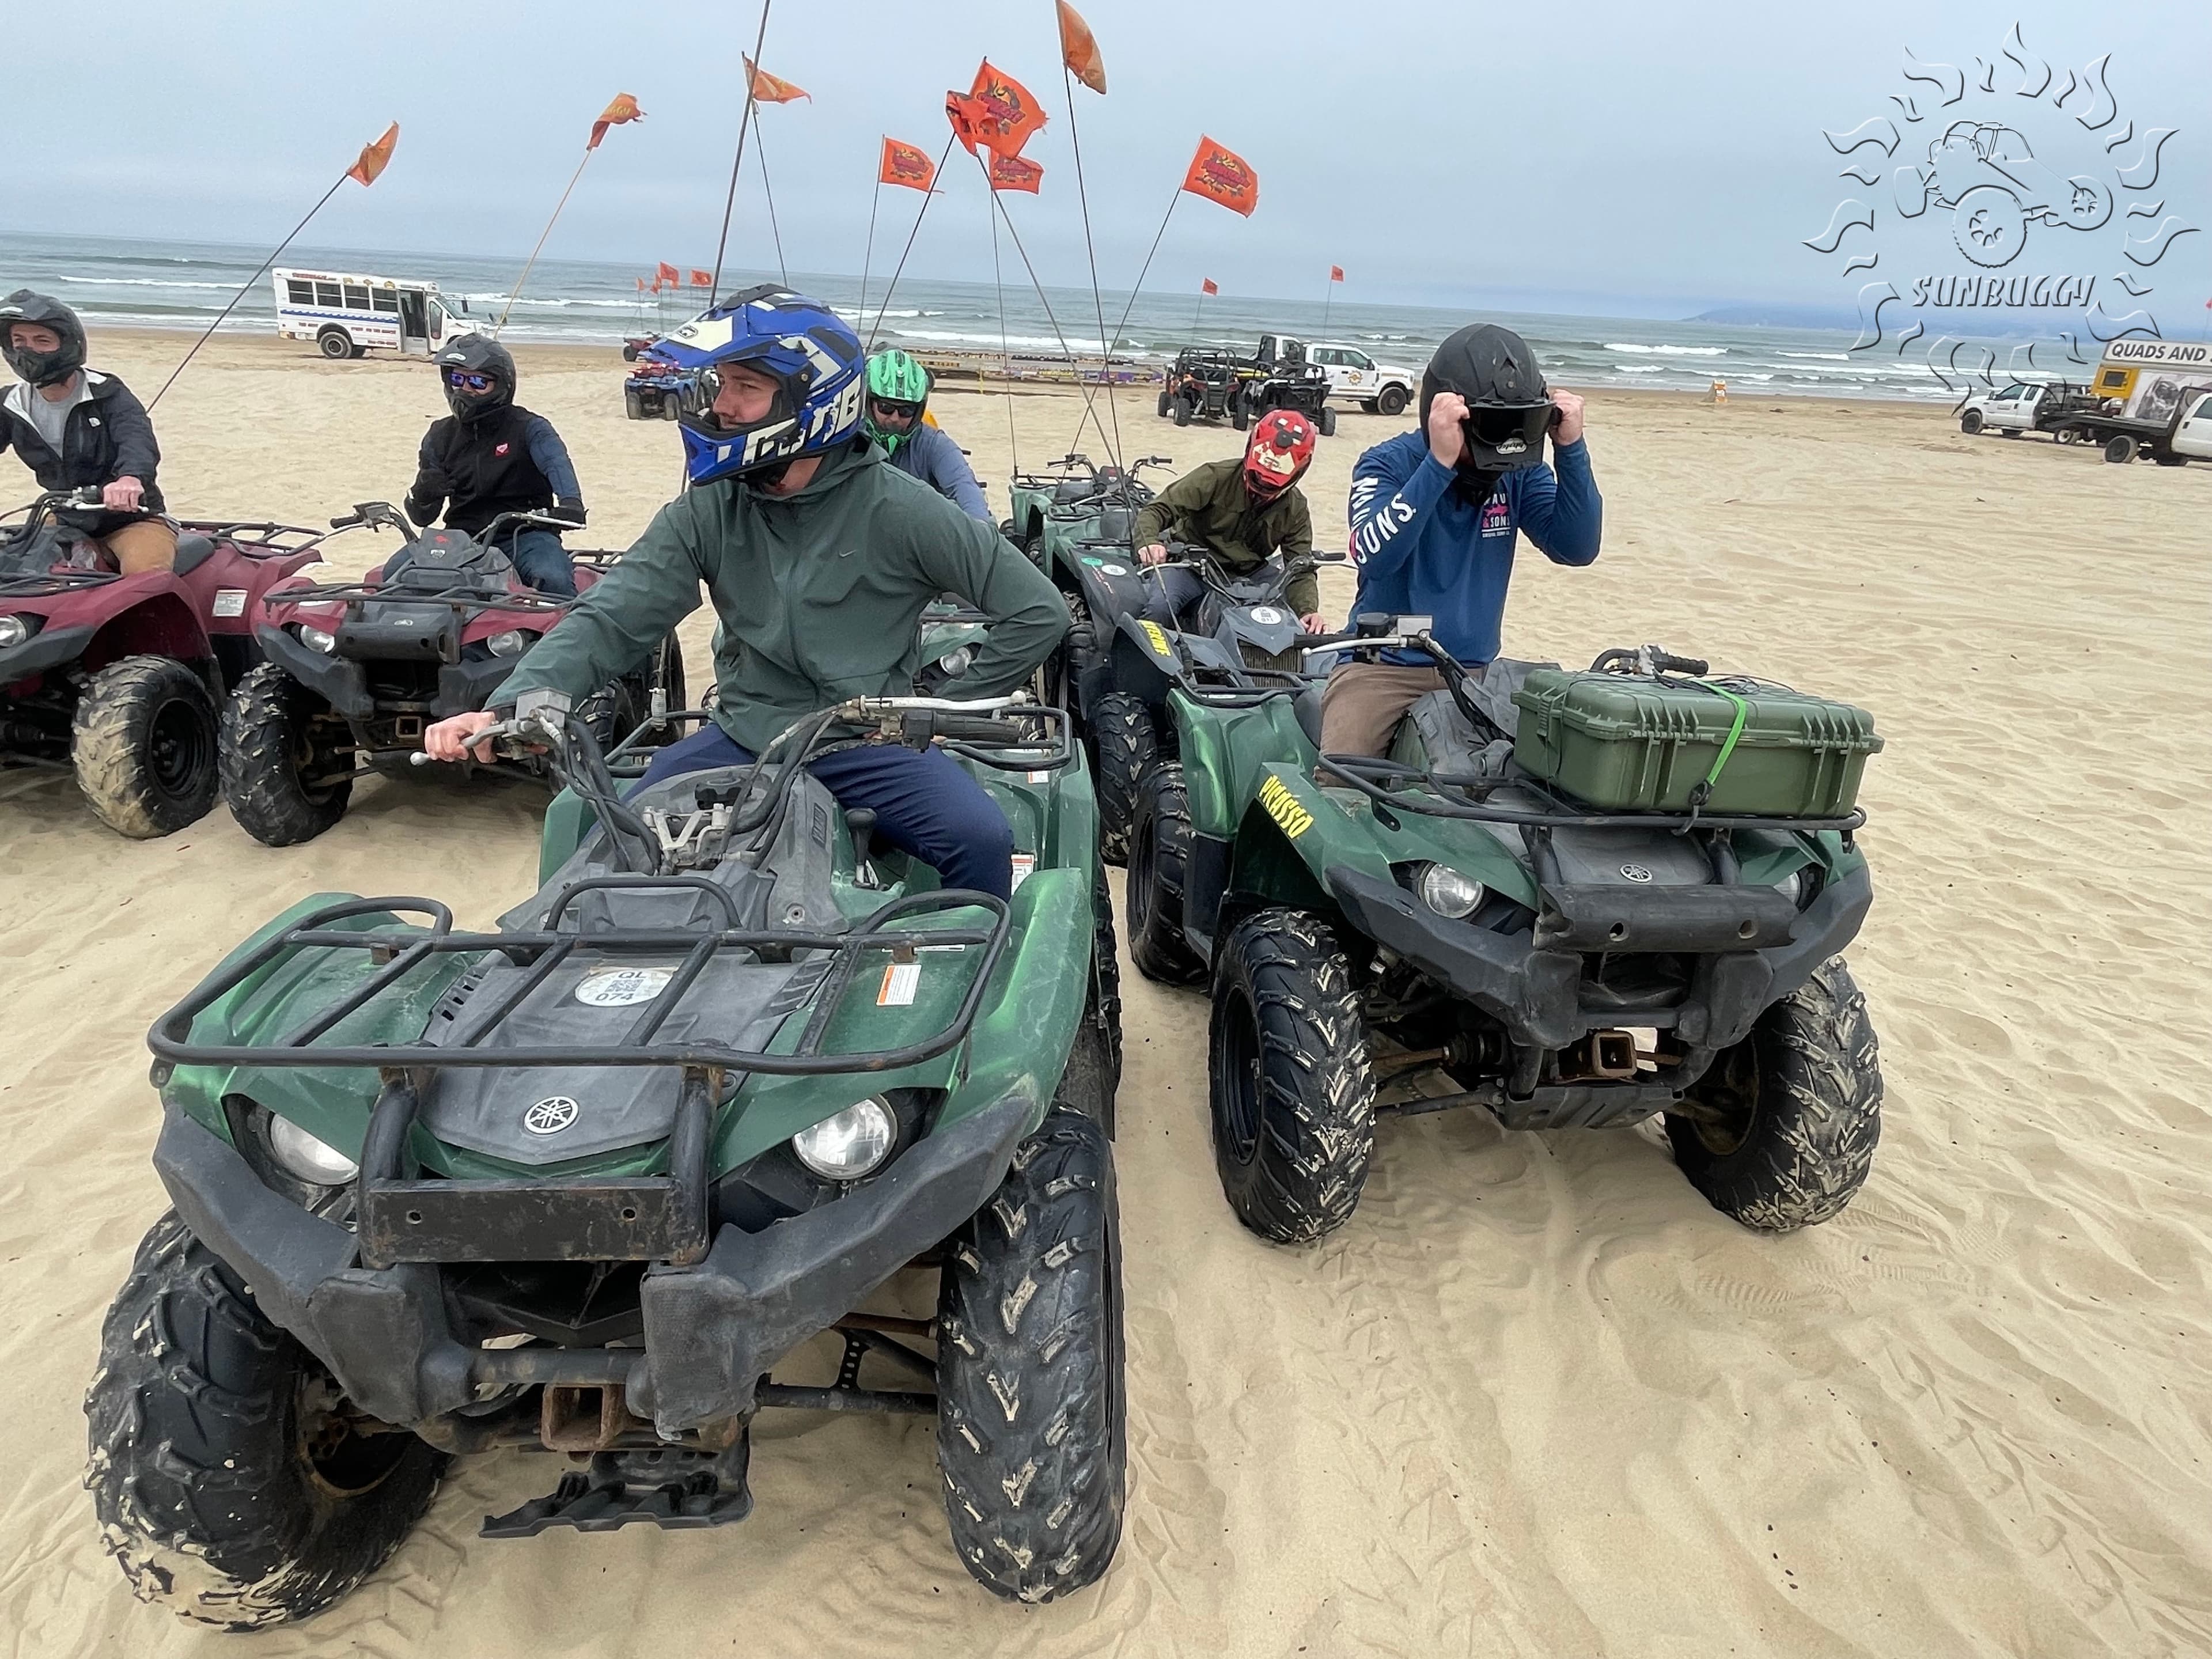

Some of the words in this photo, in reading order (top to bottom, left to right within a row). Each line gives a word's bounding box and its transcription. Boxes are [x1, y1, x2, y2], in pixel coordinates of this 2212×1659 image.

[2112, 343, 2166, 358] QUADS
[2168, 347, 2207, 361] AND
[1259, 774, 1314, 839] PICASSO
[595, 993, 634, 1001] 074
